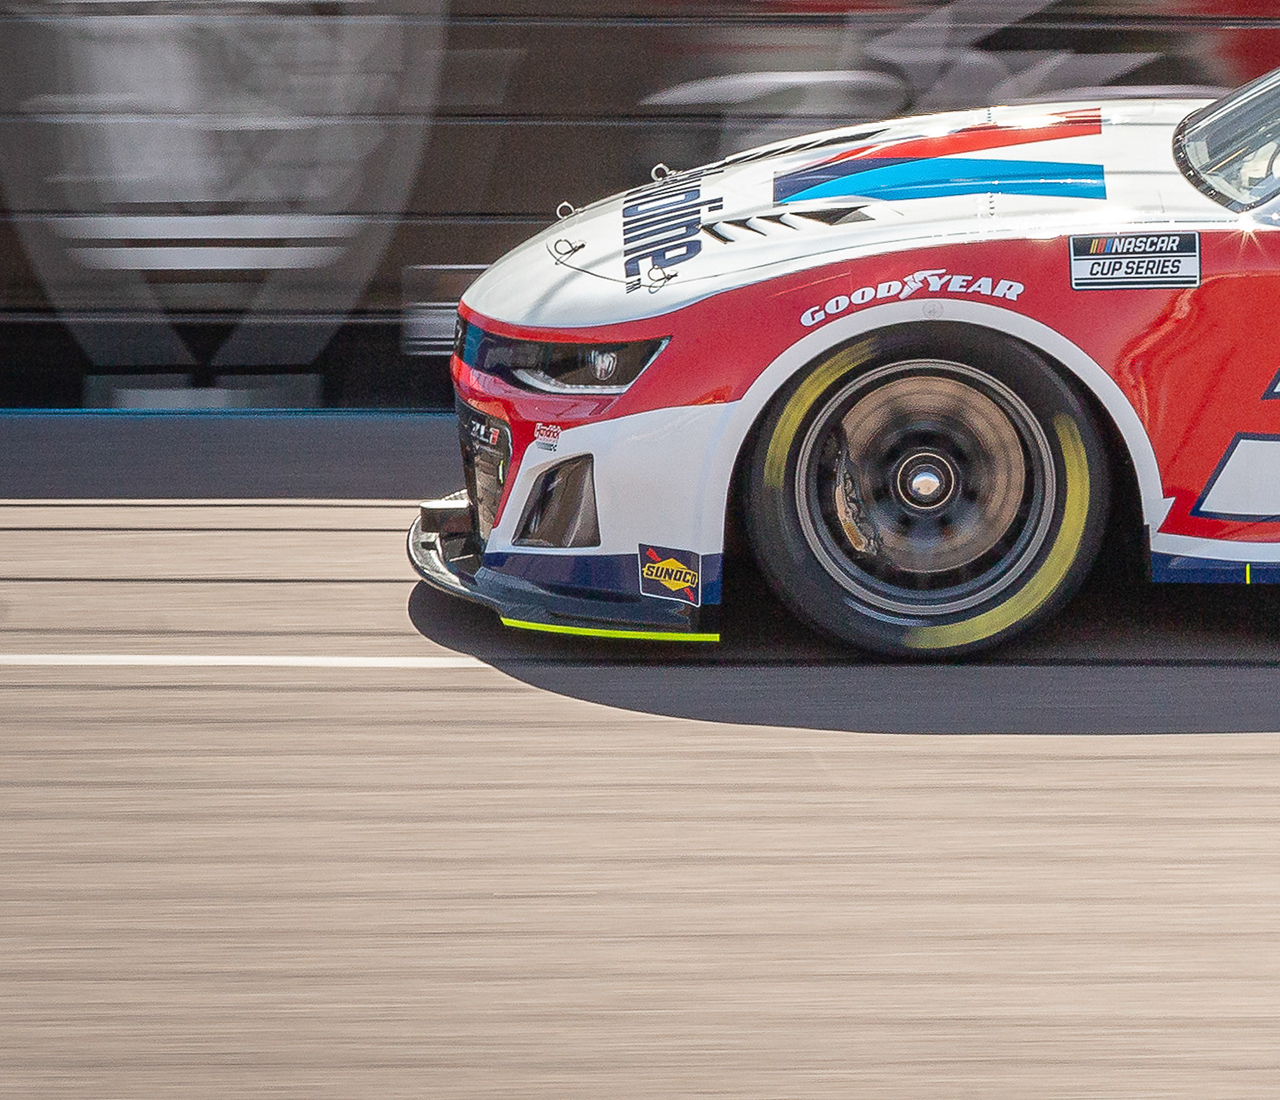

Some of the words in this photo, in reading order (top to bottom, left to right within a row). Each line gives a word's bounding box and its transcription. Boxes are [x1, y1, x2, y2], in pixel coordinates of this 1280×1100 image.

[1111, 236, 1181, 253] NASCAR
[1089, 261, 1123, 277] CUP
[1124, 259, 1182, 276] SERIES
[800, 268, 1025, 328] GOODYEAR
[644, 564, 698, 586] SUNOCO
